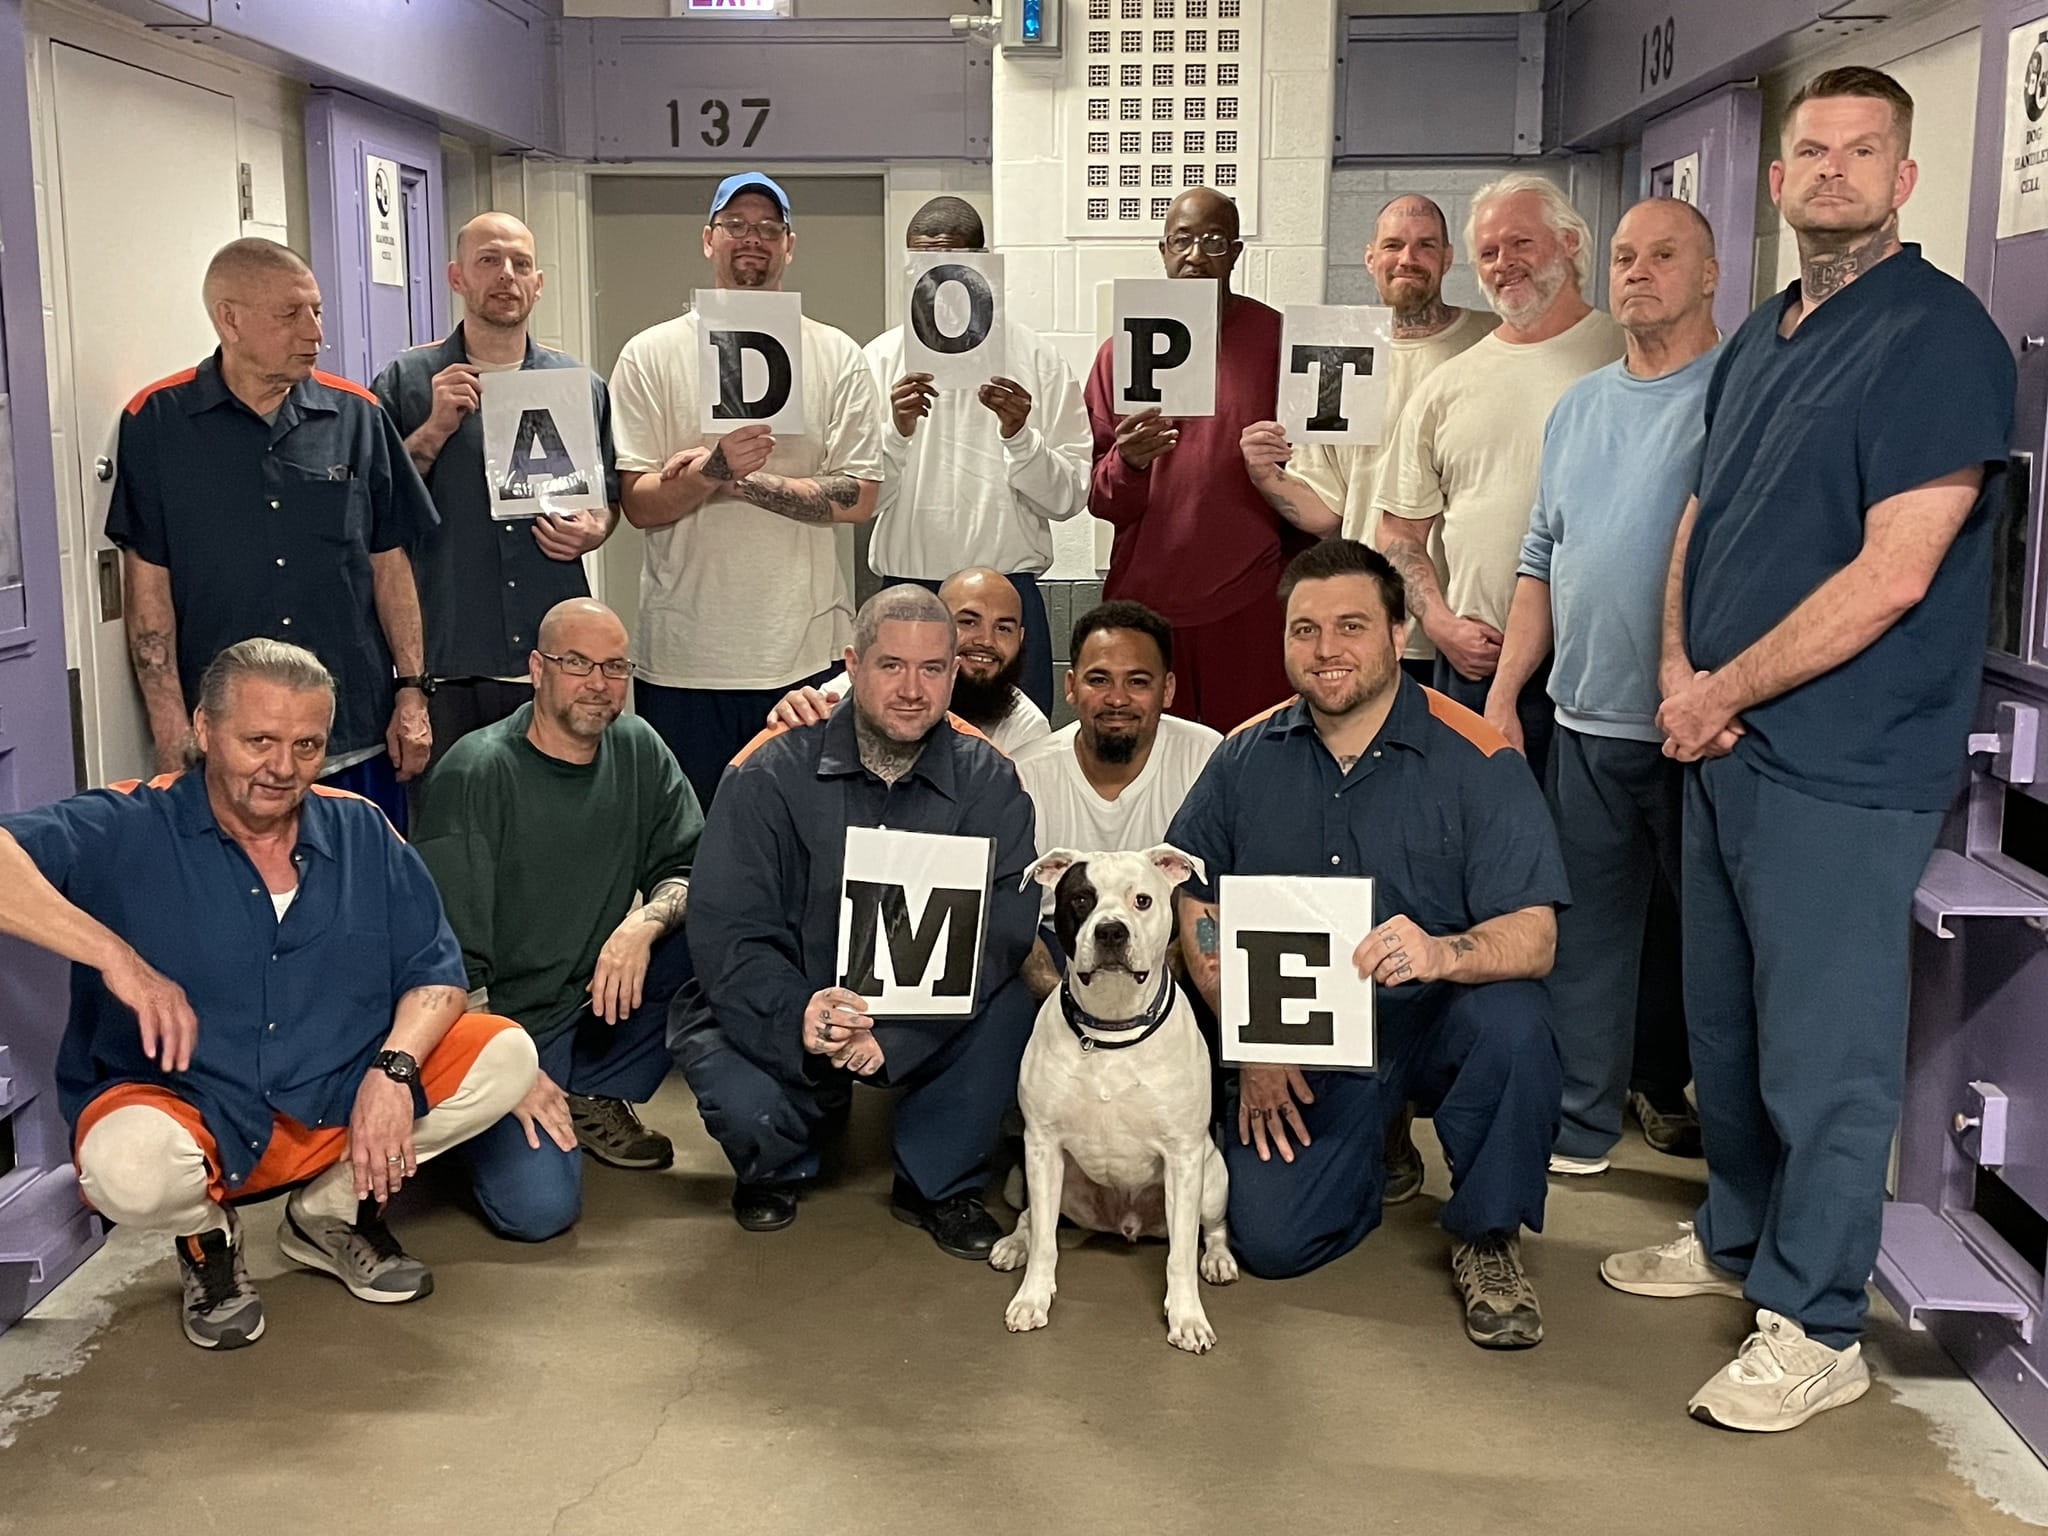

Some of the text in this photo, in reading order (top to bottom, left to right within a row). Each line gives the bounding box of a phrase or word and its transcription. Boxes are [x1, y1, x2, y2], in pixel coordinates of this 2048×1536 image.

[1640, 15, 1675, 93] 138
[666, 98, 771, 148] 137
[2014, 149, 2048, 171] HANDLE
[2026, 127, 2042, 144] DOG
[2021, 177, 2040, 194] CELL
[911, 264, 993, 354] O
[709, 331, 792, 419] D
[1123, 318, 1191, 402] P
[1291, 345, 1374, 431] T
[500, 409, 589, 500] A
[839, 880, 982, 996] M
[1236, 930, 1334, 1045] E
